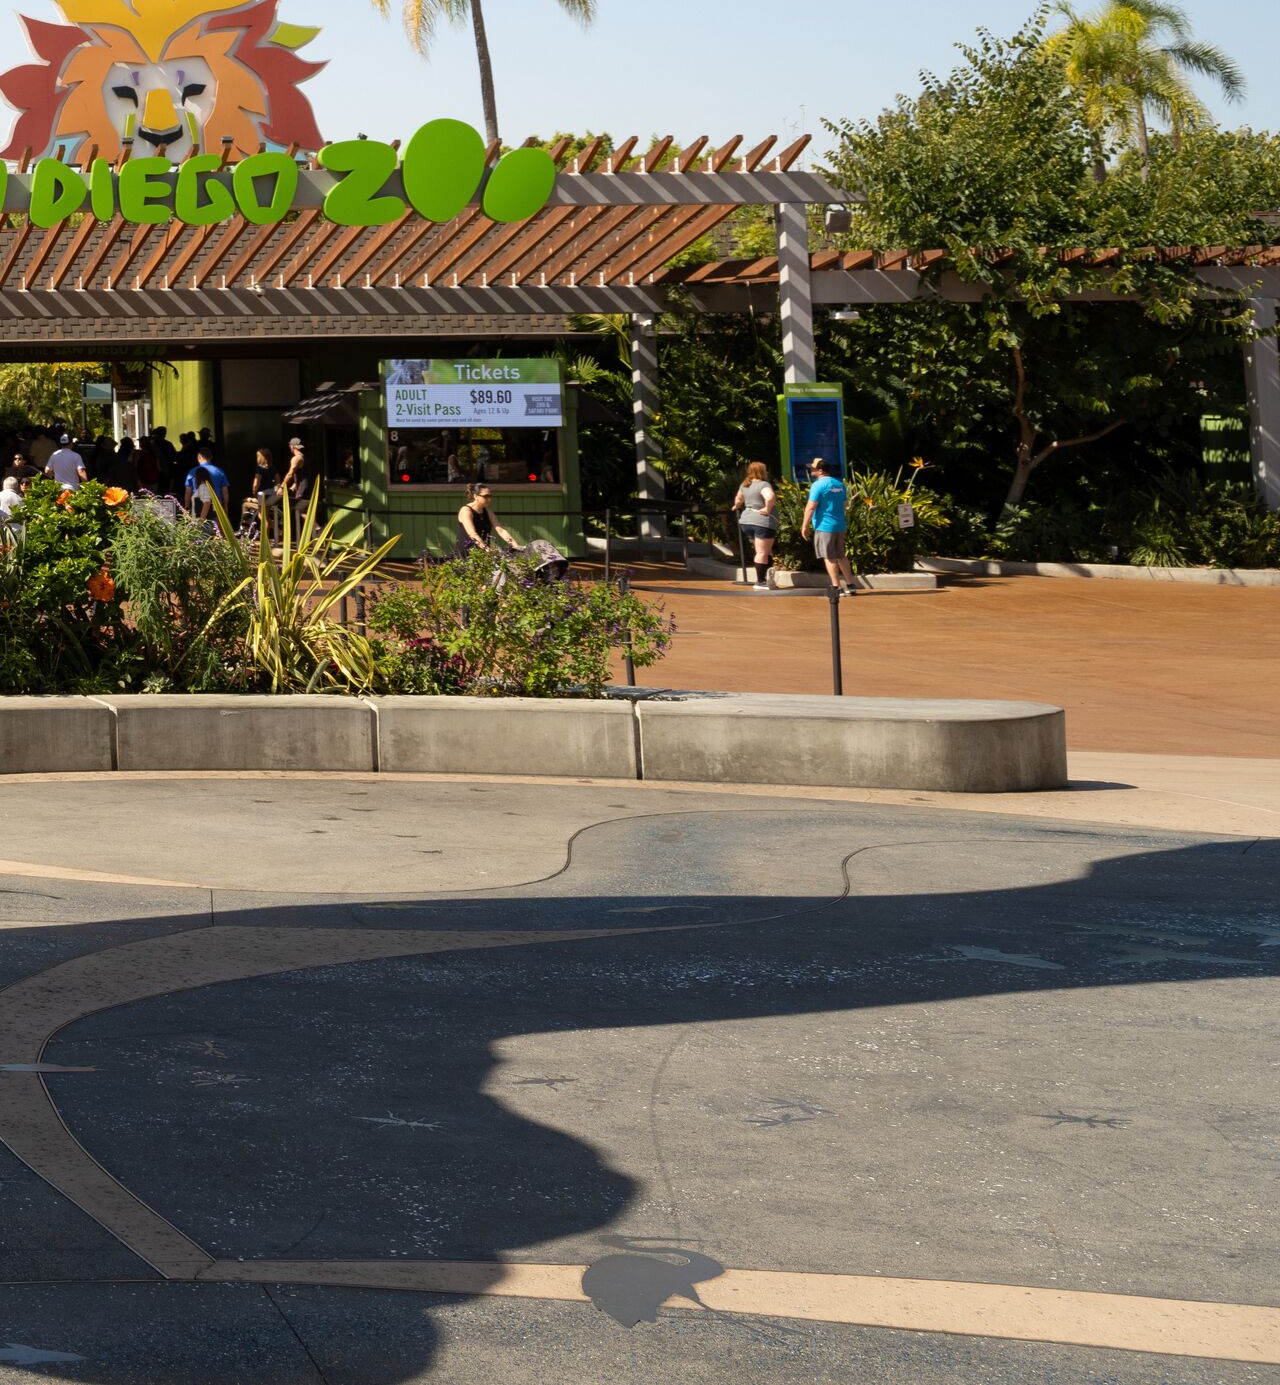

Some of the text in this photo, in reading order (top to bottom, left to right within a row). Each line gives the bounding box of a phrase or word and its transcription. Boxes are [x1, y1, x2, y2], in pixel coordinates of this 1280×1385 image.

[30, 152, 298, 227] DIEGO
[318, 118, 557, 226] ZOO
[454, 364, 520, 380] Tickets
[395, 389, 427, 400] ADULT
[470, 389, 512, 405] $89.60
[396, 403, 461, 415] 2-Visit Pass
[390, 431, 398, 441] 8
[542, 431, 549, 441] 7
